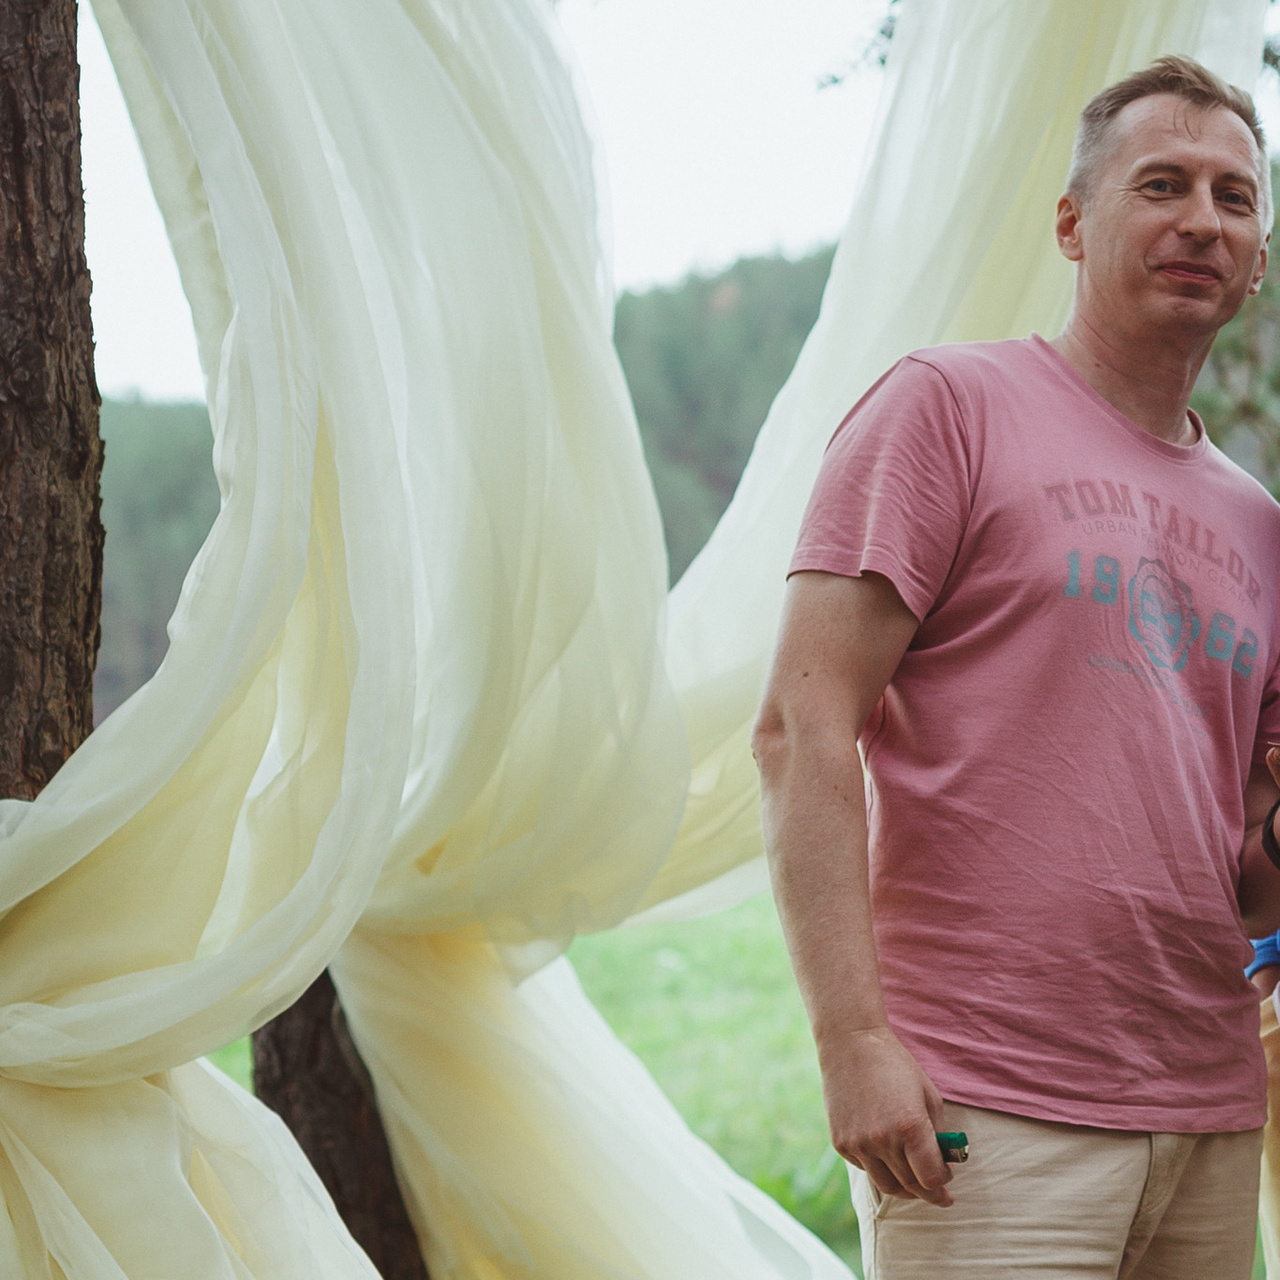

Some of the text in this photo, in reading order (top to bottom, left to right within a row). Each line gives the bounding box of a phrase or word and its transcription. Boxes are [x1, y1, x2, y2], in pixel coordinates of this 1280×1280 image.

[1044, 480, 1138, 522] TOM
[1081, 519, 1138, 537] URBAN
[1063, 549, 1120, 606] 19
